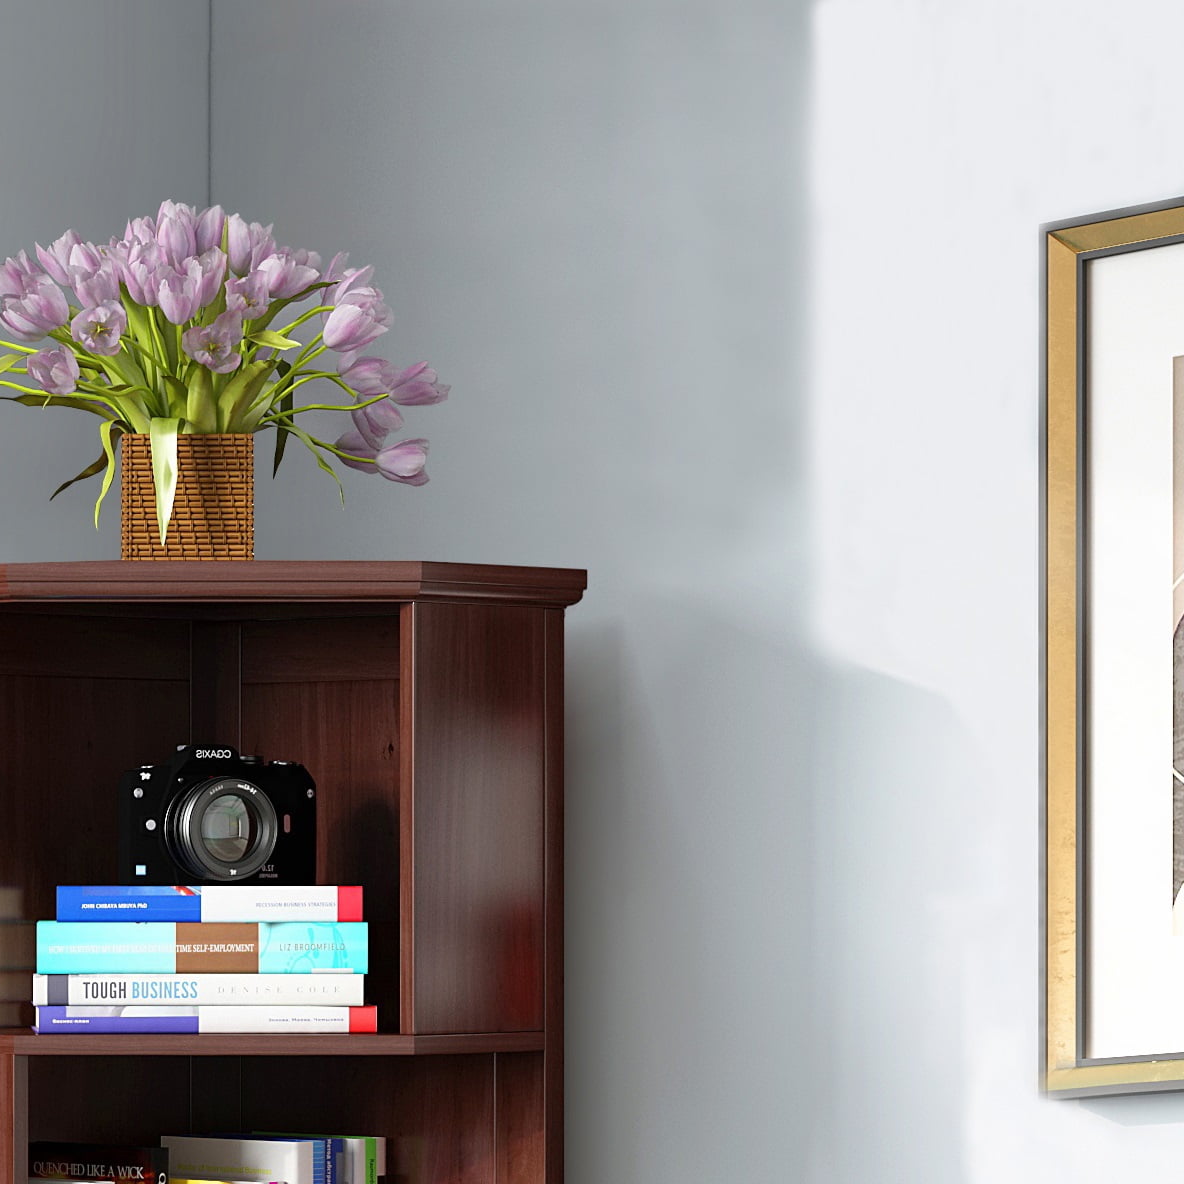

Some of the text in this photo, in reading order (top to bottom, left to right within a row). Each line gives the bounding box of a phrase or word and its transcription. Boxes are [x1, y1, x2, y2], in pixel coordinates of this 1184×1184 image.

[193, 944, 254, 953] SELF-EMPLOYMENT
[279, 943, 346, 951] LIZ BROOMFIELD
[83, 981, 198, 999] TOUGH BUSINESS
[33, 1161, 144, 1179] QUENCHED LIKE A WICK
